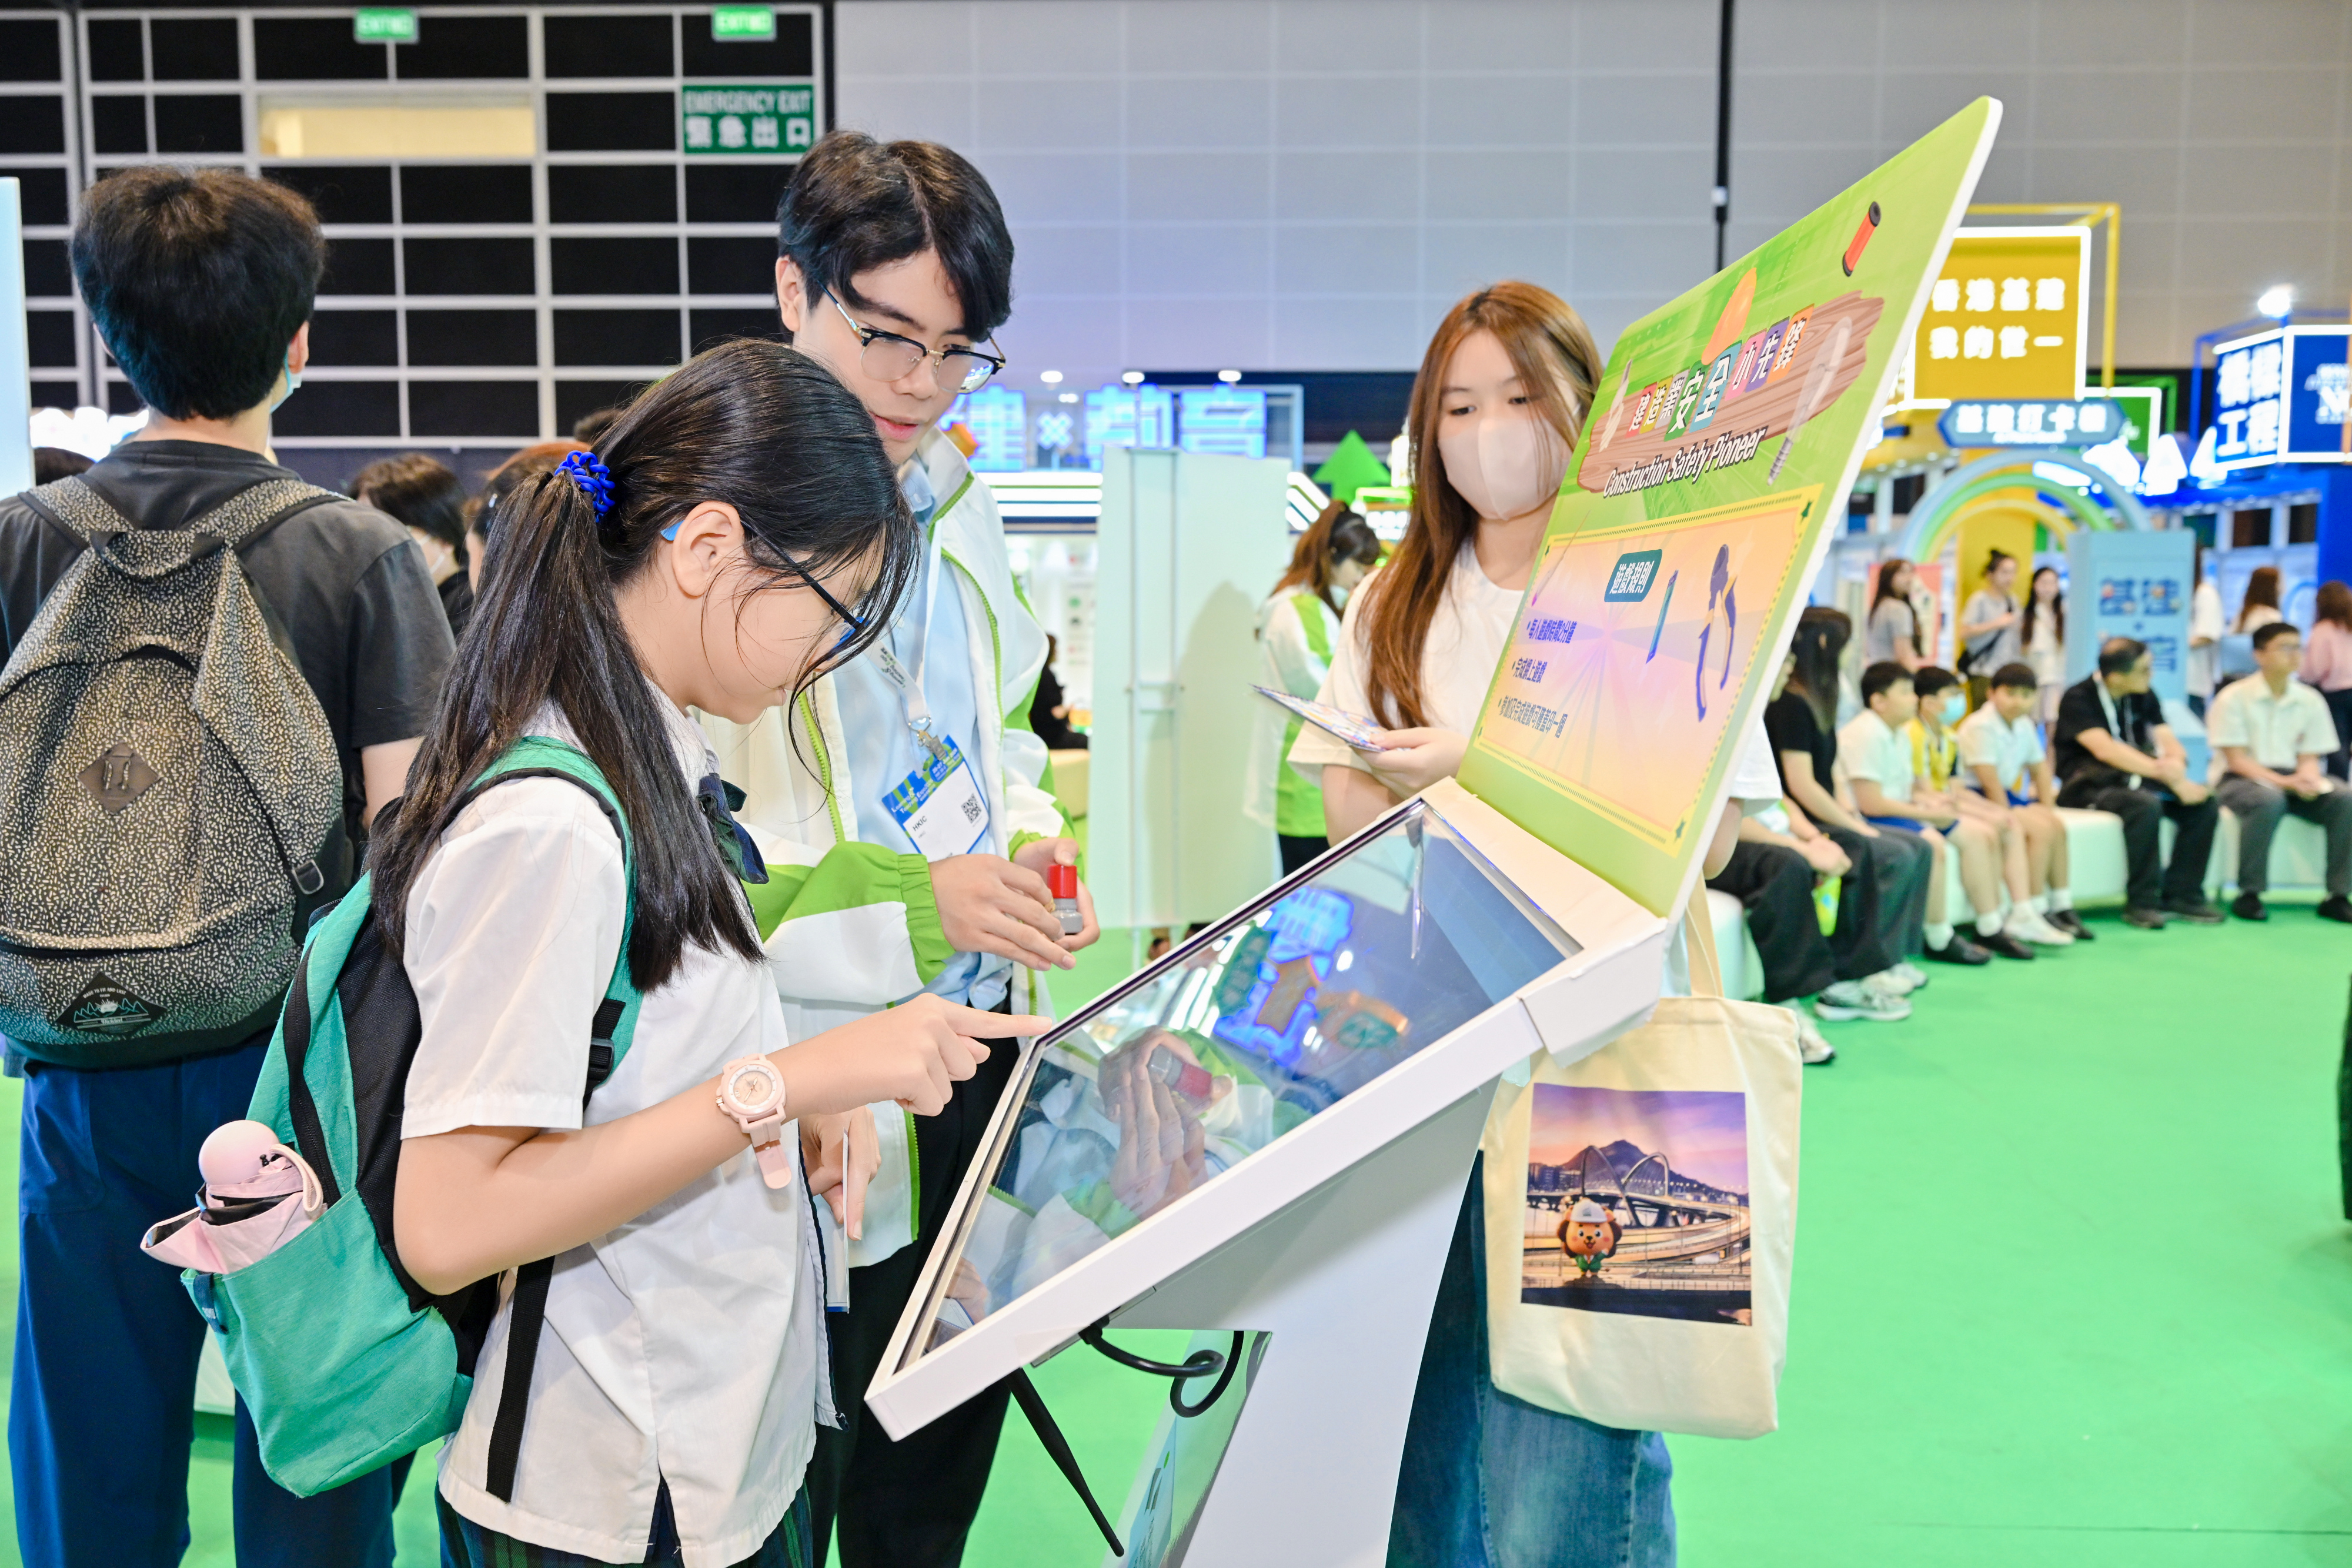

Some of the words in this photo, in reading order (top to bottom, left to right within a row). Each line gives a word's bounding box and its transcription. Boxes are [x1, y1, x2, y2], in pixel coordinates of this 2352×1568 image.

[684, 90, 774, 114] EMERGENCY
[777, 90, 811, 114] EXIT
[686, 115, 811, 149] 緊急出口
[1629, 316, 1808, 434] 建造業安全小先鋒
[1603, 454, 1671, 499] Construction
[1666, 441, 1713, 484] Safety
[1705, 426, 1769, 473] Pioneer
[1609, 560, 1655, 594] 遊戲規則
[913, 815, 927, 831] HKIC
[83, 991, 95, 999] MADE
